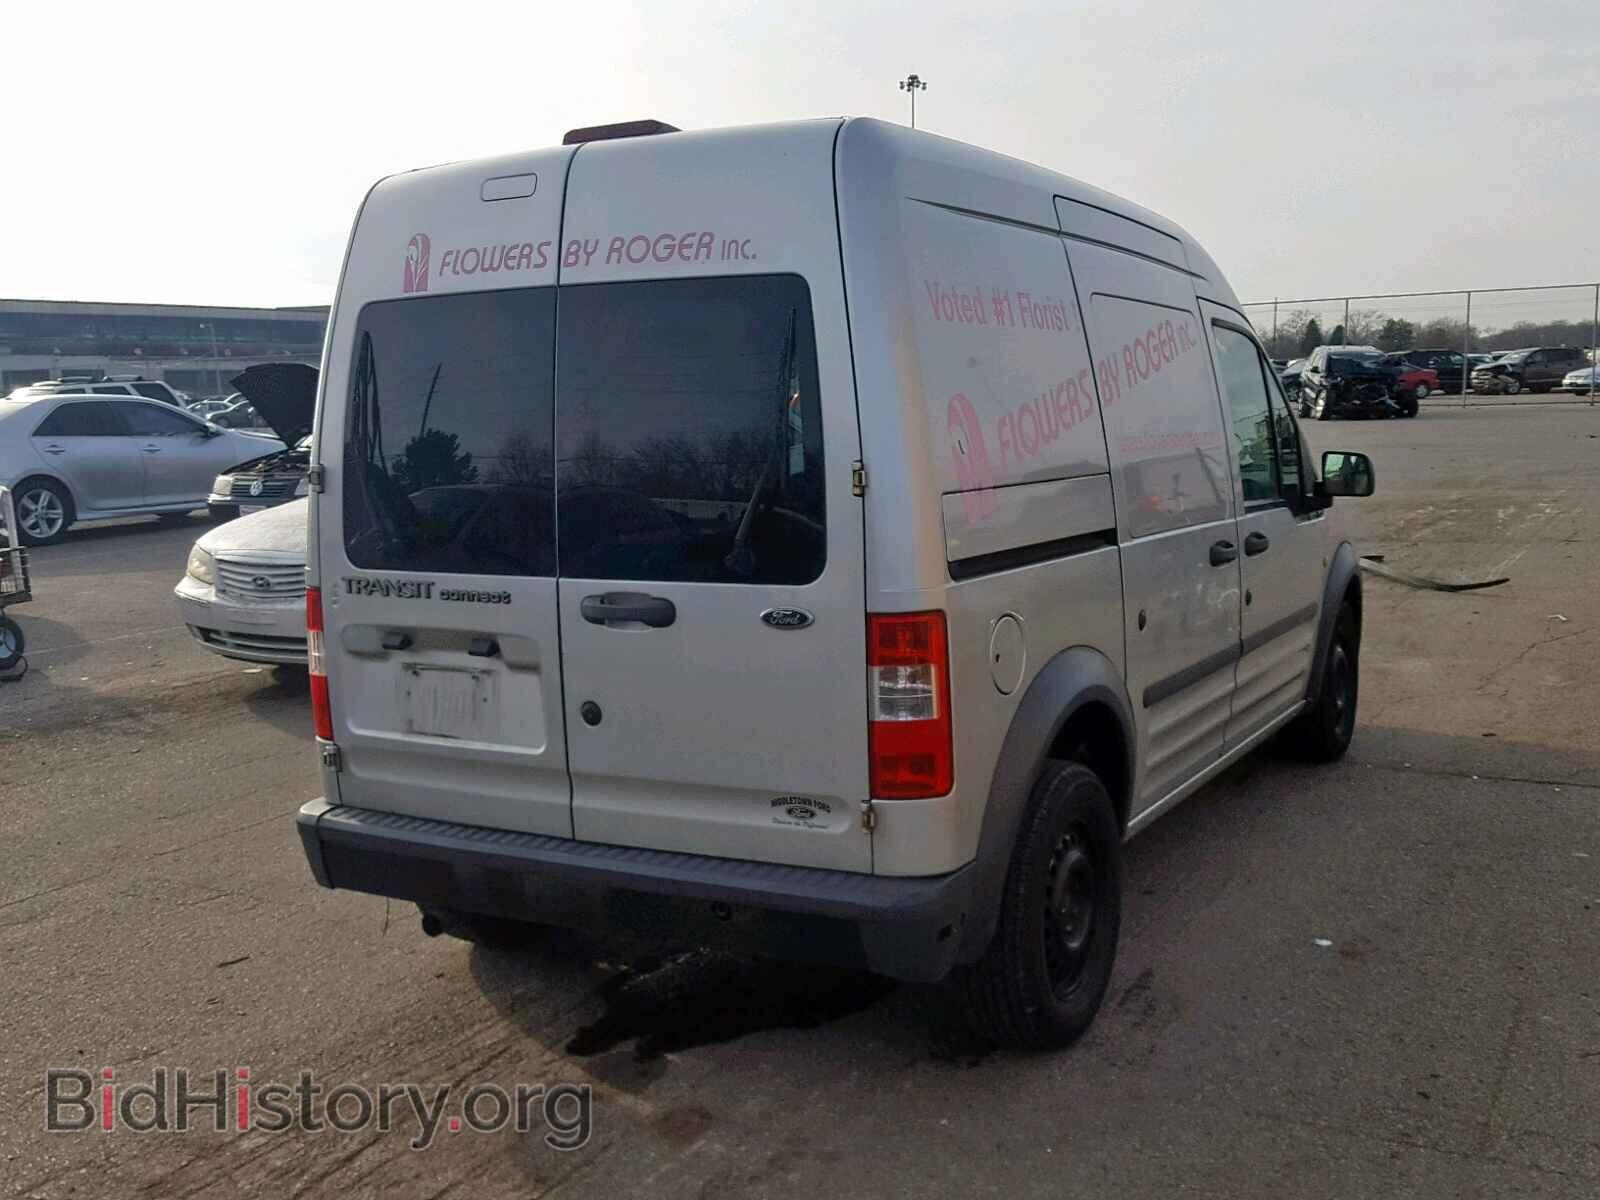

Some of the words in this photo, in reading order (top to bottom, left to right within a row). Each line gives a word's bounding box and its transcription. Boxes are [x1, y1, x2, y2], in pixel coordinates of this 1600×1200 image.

[439, 241, 552, 277] FLOWERS
[563, 238, 599, 268] BY
[606, 231, 713, 264] ROGER
[925, 280, 987, 325] Voted
[998, 369, 1094, 465] FLOWERS
[1099, 353, 1121, 409] BY
[1124, 319, 1181, 388] ROGER
[342, 576, 435, 600] TRANSIT
[769, 609, 801, 624] Ford
